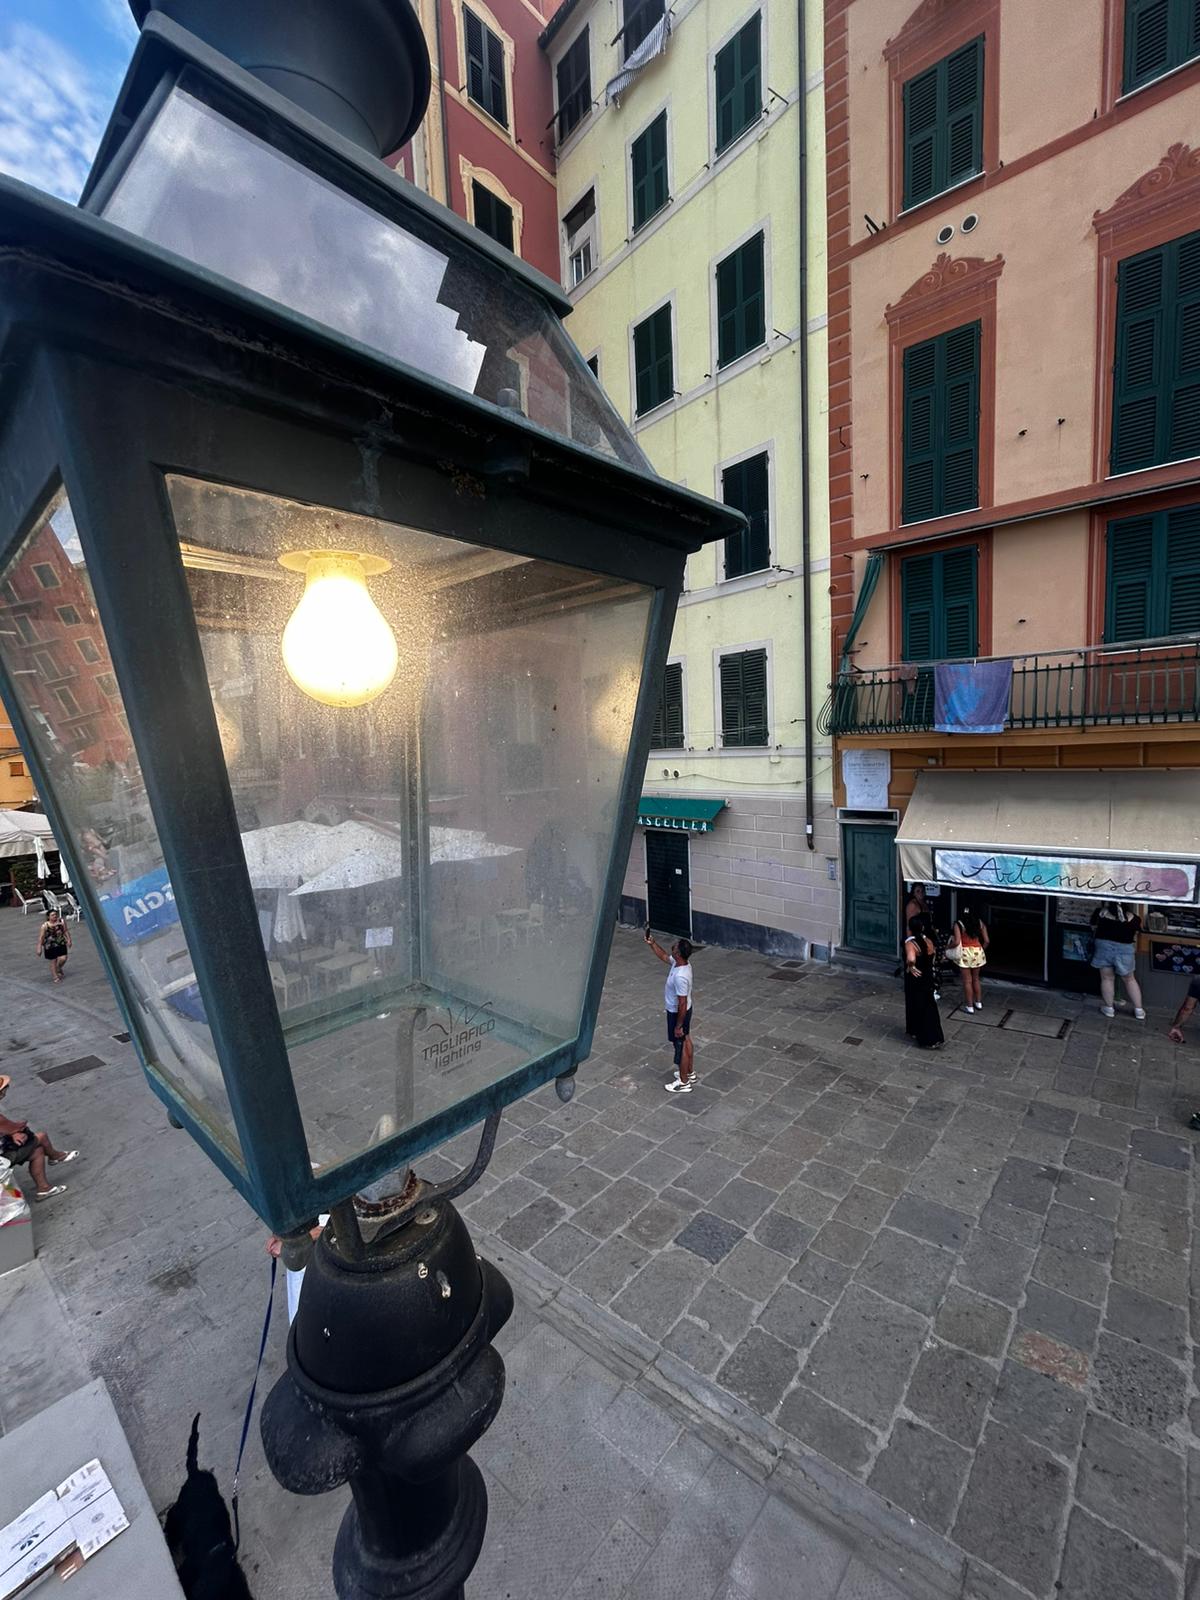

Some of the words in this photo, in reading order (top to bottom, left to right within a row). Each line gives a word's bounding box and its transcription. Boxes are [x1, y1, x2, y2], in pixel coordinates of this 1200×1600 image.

[961, 857, 1169, 893] Artemisia
[422, 1019, 496, 1061] TAGLIAFICO
[434, 1040, 482, 1069] lighting
